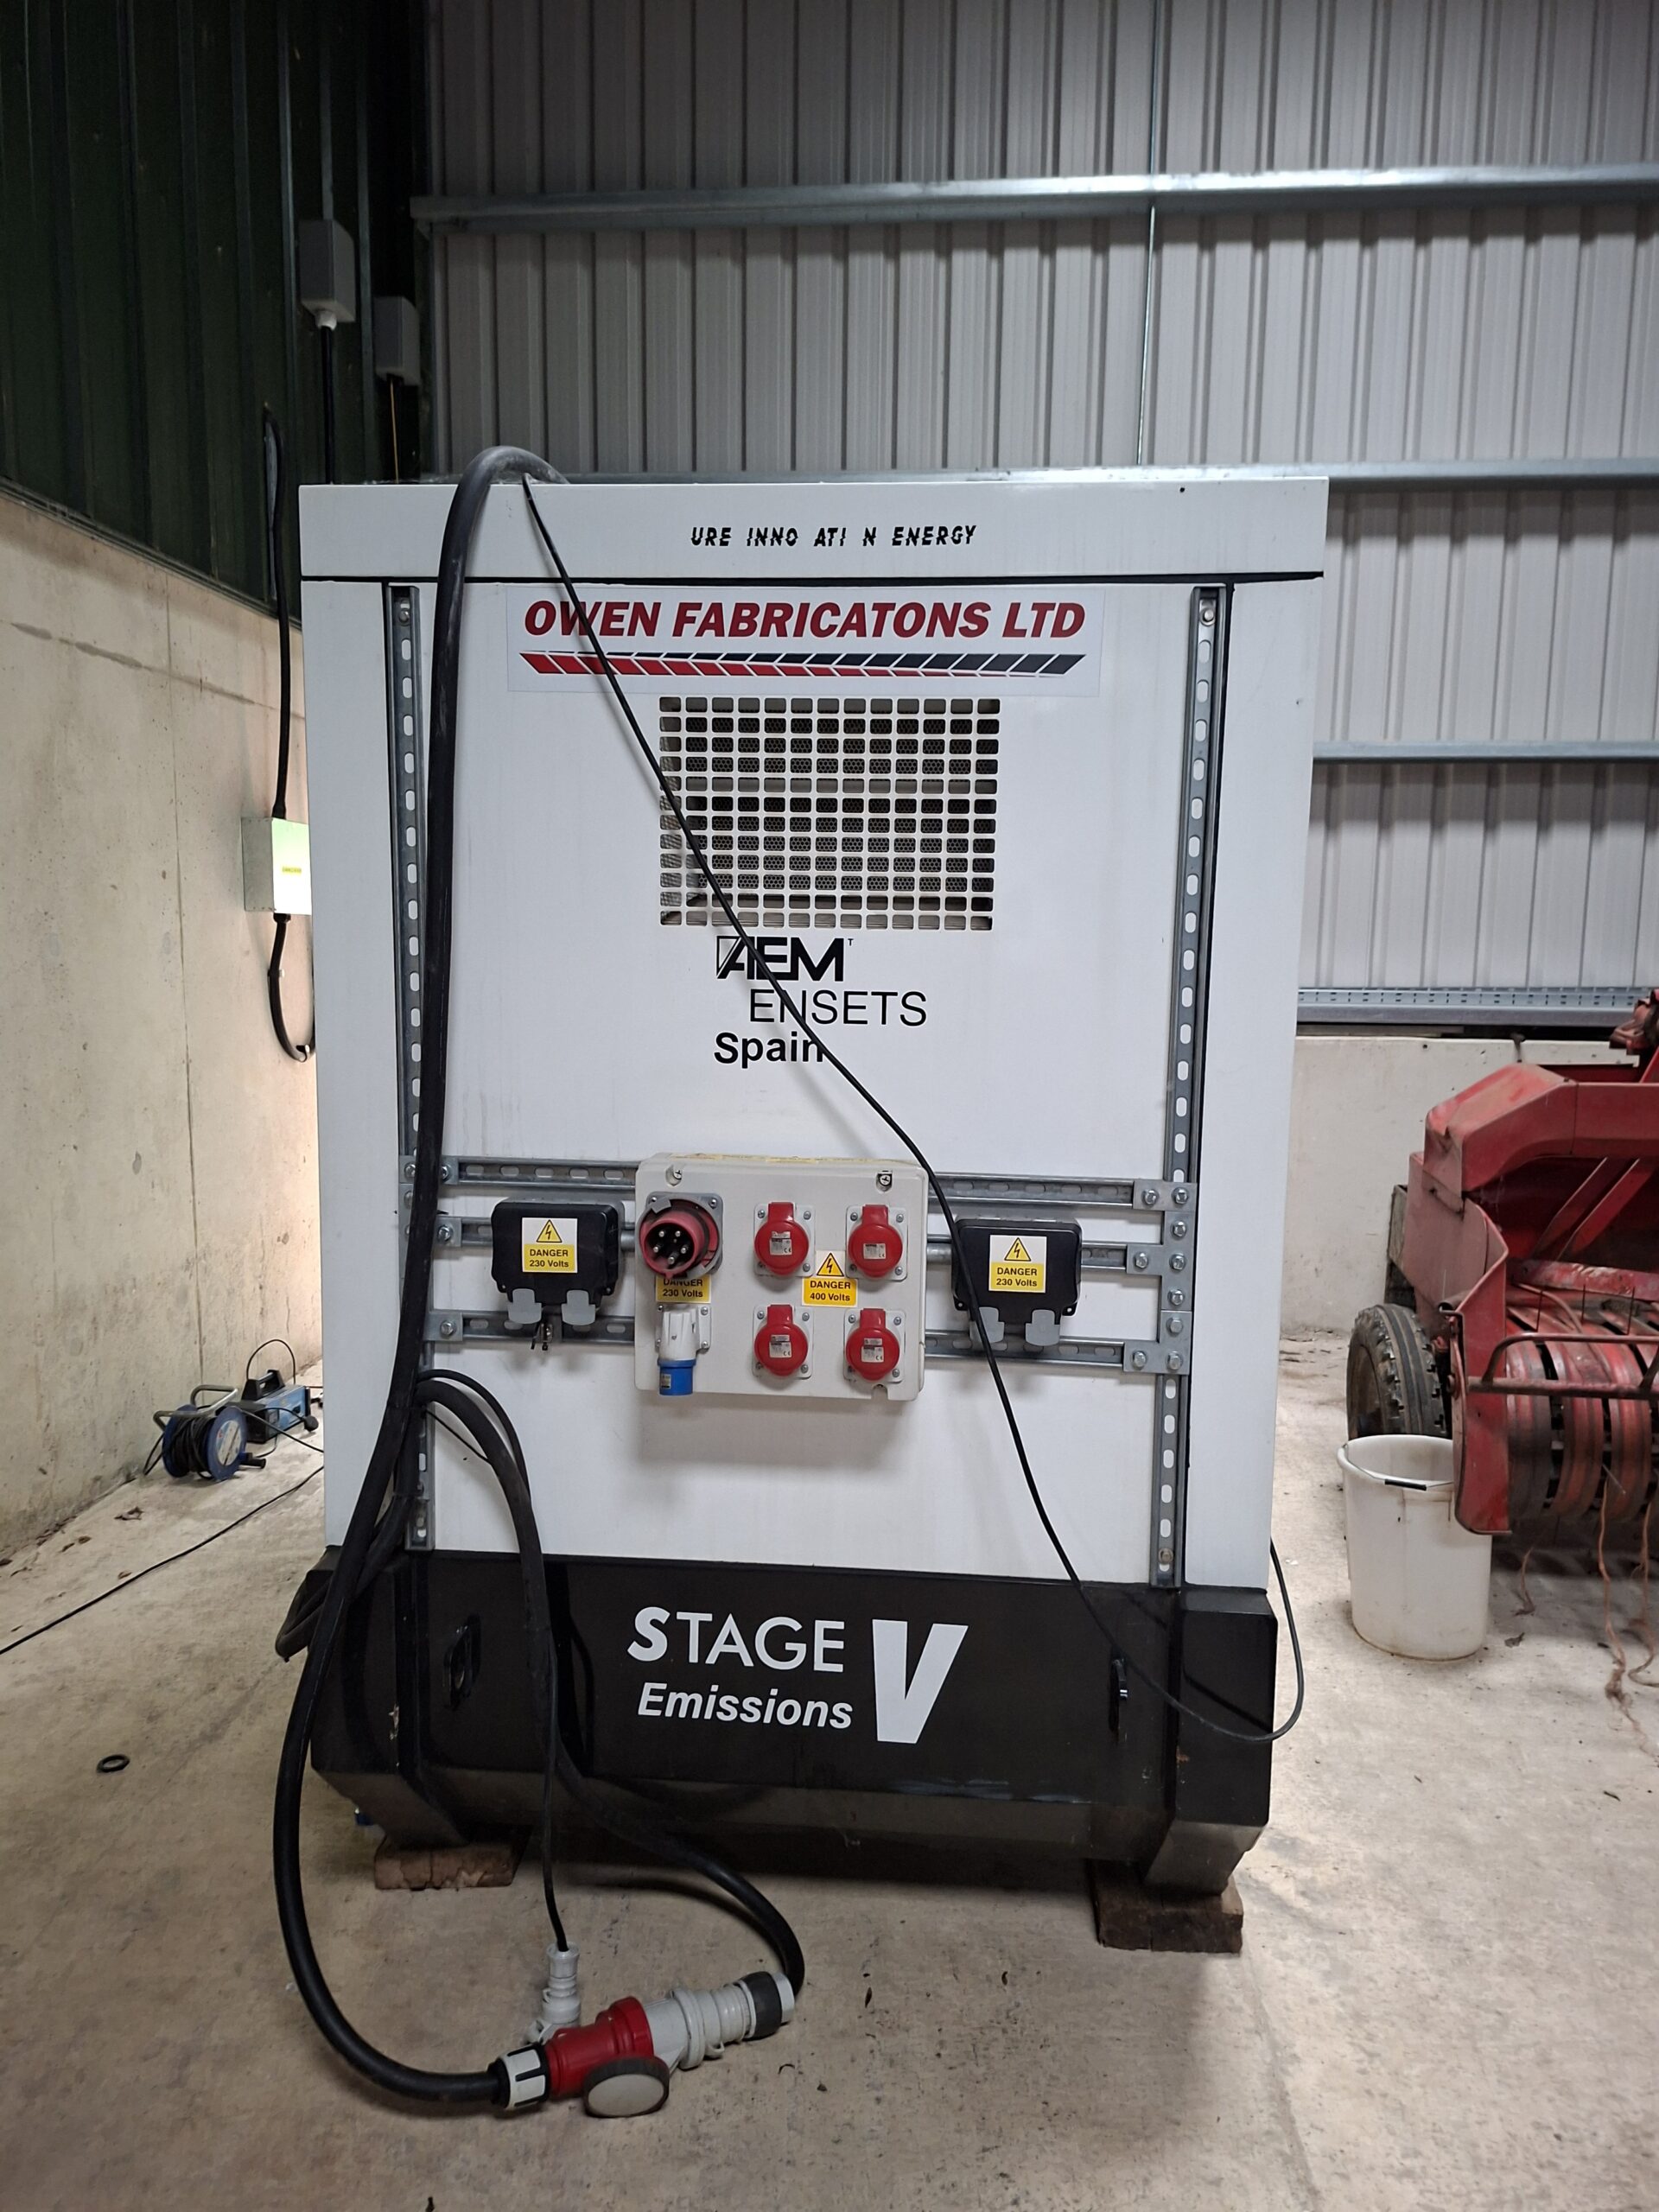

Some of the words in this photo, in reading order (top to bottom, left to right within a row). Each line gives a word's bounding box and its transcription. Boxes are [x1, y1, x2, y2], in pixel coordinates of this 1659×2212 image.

[690, 526, 732, 547] URE
[747, 526, 799, 547] INNO
[813, 526, 847, 547] ATI
[862, 526, 878, 547] N
[892, 524, 977, 547] ENERGY
[524, 600, 663, 637] OWEN
[671, 601, 992, 639] FABRICATONS
[1001, 601, 1086, 639] LTD
[715, 935, 845, 982] AEM
[749, 988, 928, 1027] ENSETS
[714, 1031, 824, 1070] Spain
[529, 1249, 569, 1257] DANGER
[529, 1259, 546, 1268] 230
[547, 1259, 569, 1268] Volts
[996, 1267, 1038, 1276] DANGER
[663, 1277, 704, 1287] DANGER
[810, 1280, 852, 1289] DANGER
[995, 1278, 1014, 1287] 230
[1014, 1279, 1038, 1287] Volts
[663, 1288, 680, 1297] 230
[681, 1288, 704, 1298] Volts
[810, 1292, 827, 1300] 400
[828, 1293, 851, 1301] Volts
[626, 1606, 846, 1674] STAGE
[871, 1618, 969, 1745] V
[638, 1681, 854, 1729] Emissions
